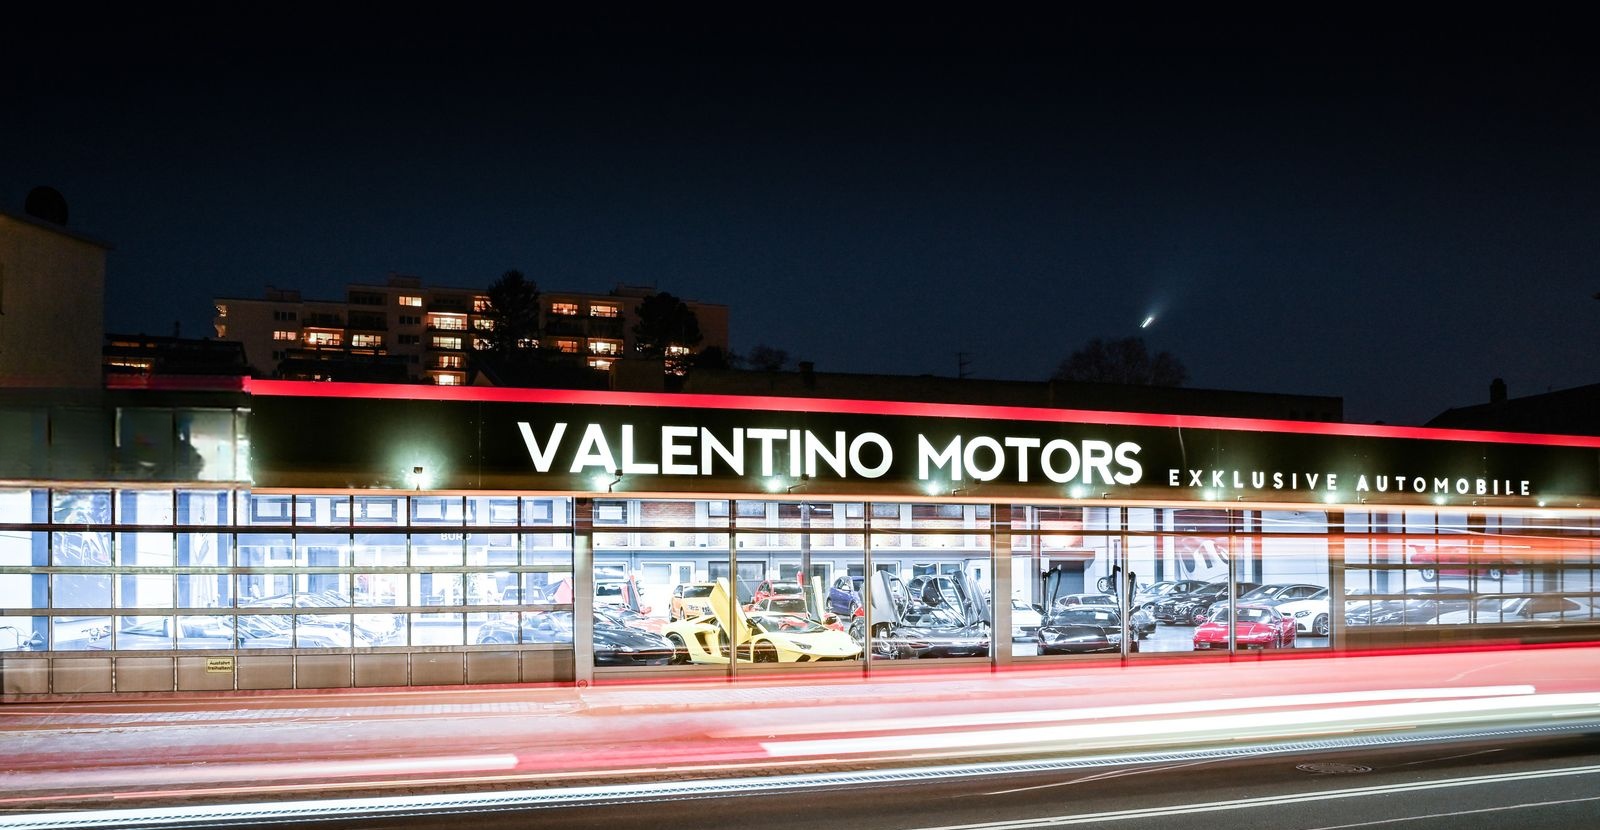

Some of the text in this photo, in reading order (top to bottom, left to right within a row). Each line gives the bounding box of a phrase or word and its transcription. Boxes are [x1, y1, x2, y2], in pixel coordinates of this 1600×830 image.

[517, 421, 1143, 485] VALENTINO MOTORS
[1169, 469, 1530, 496] EXKLUSIVE AUTOMOBILE
